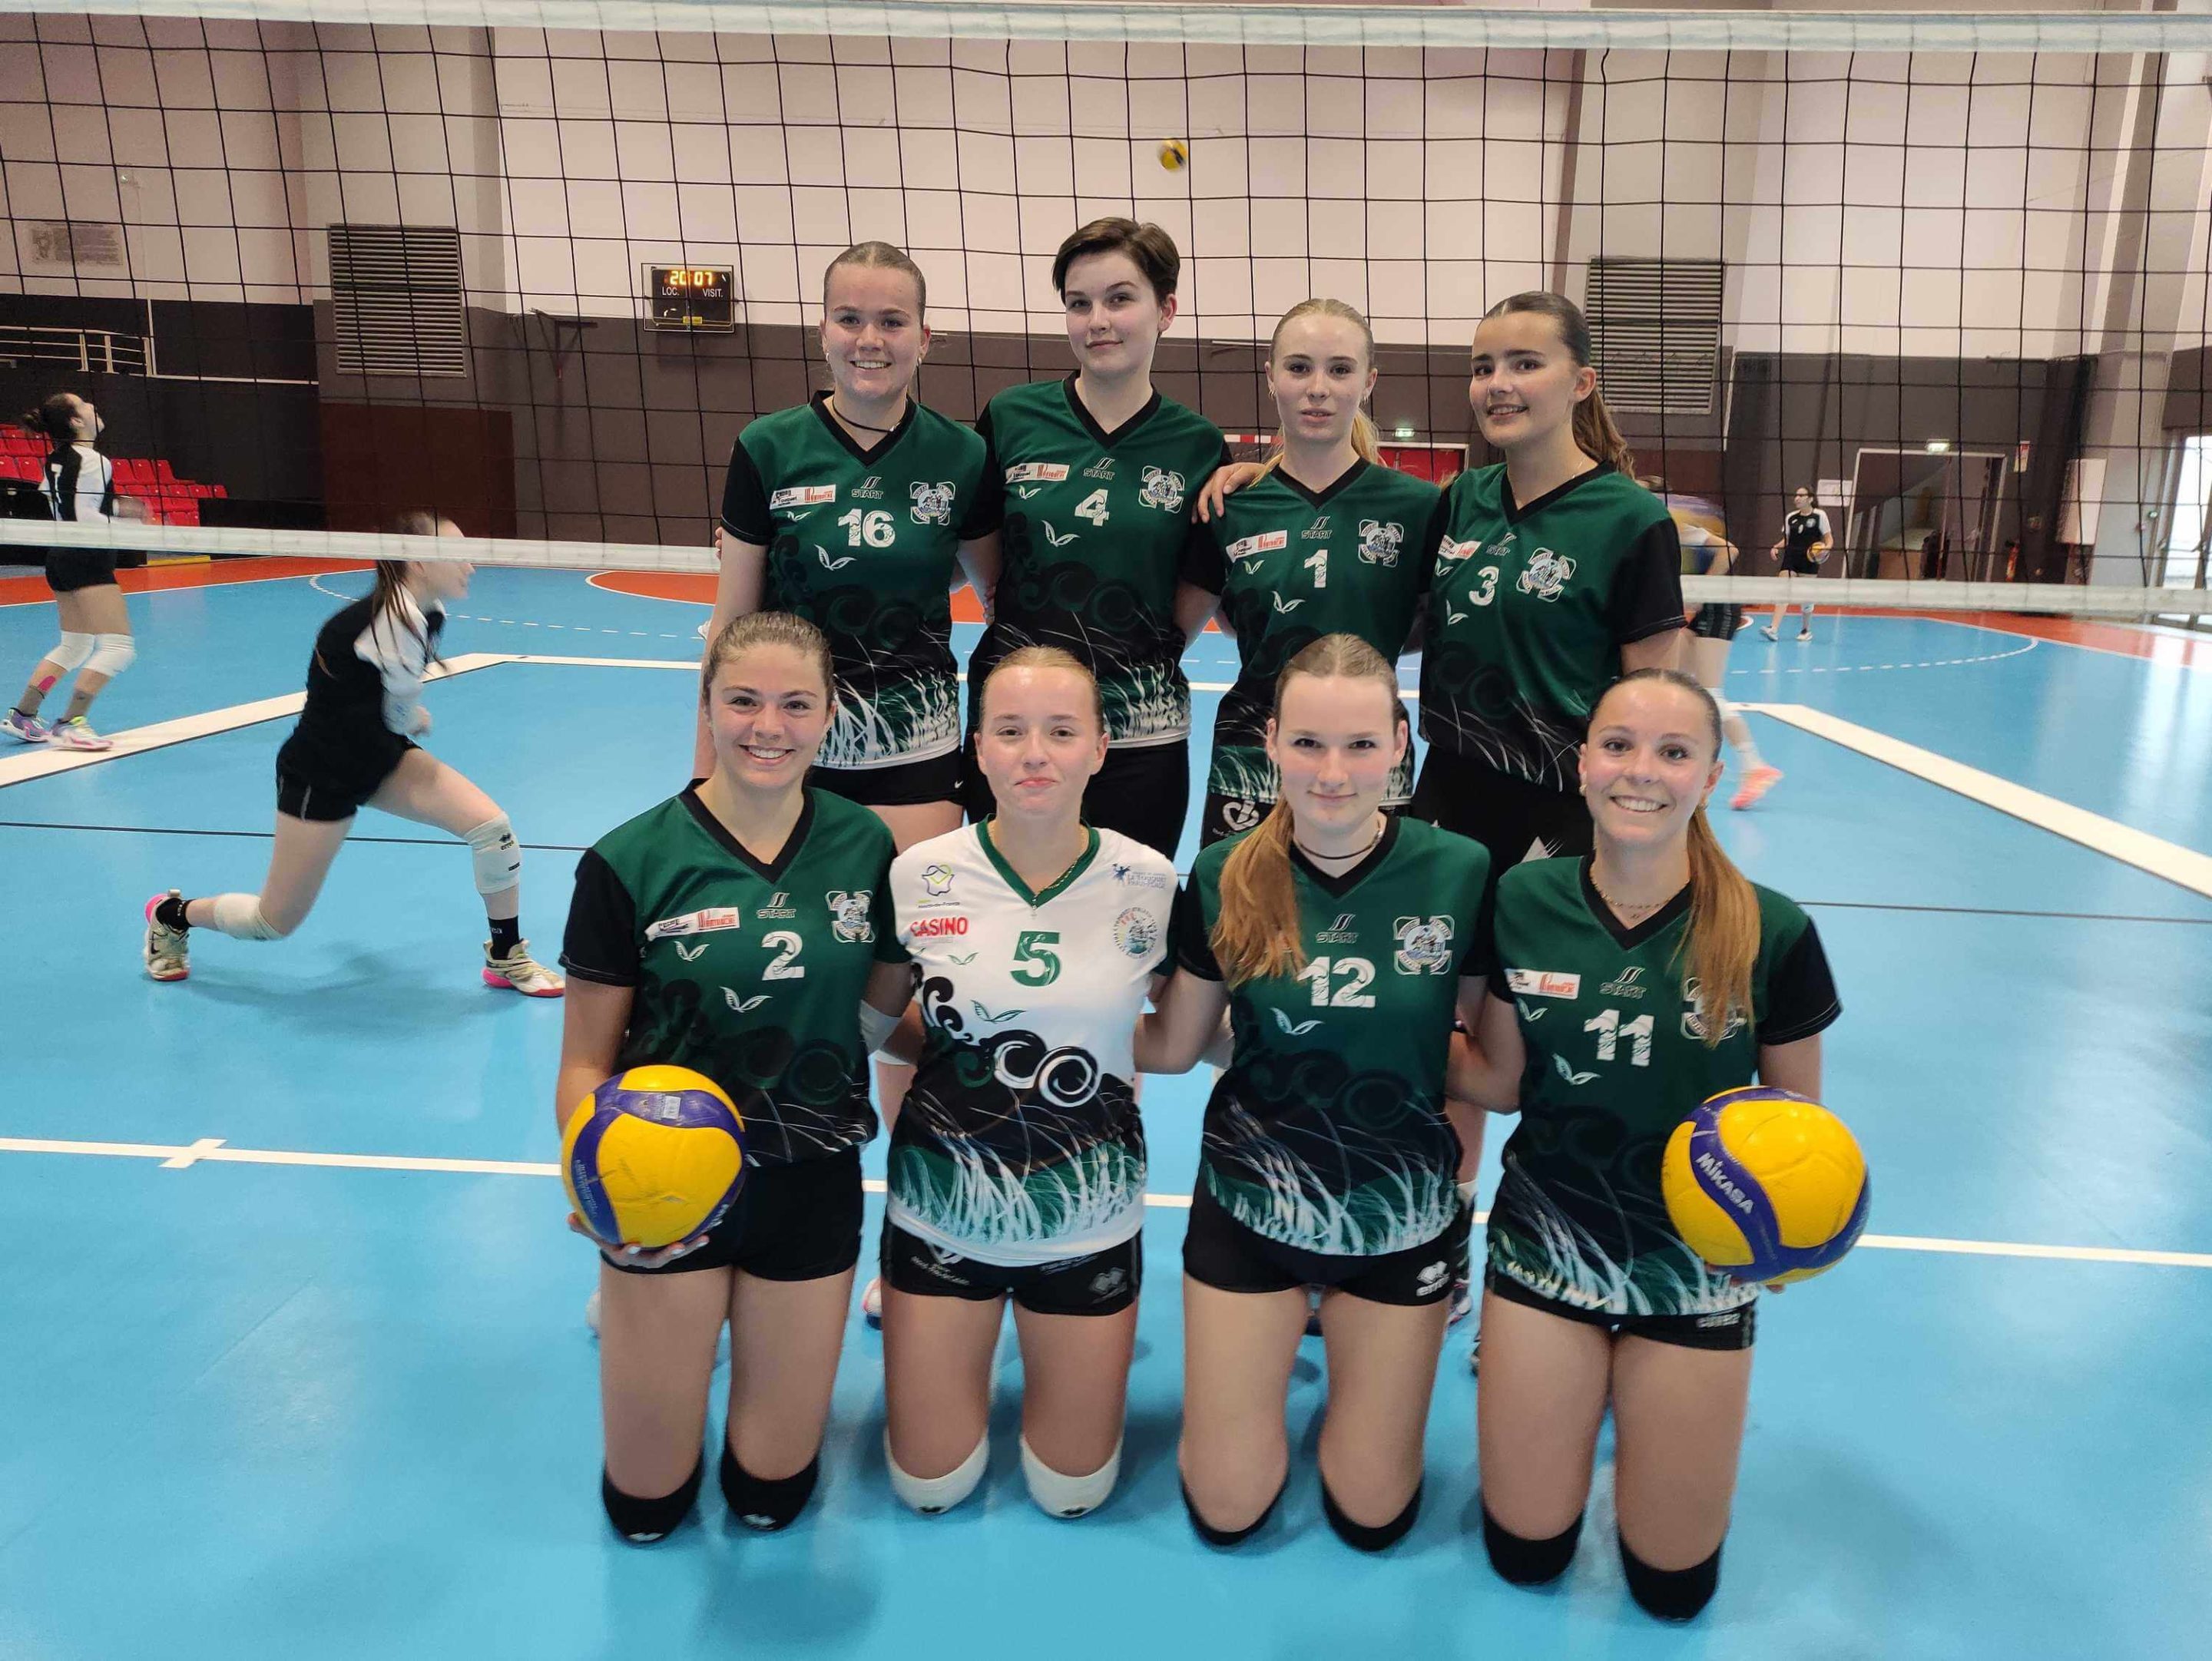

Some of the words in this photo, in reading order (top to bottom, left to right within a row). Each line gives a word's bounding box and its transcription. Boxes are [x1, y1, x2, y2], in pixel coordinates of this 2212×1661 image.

[662, 286, 680, 296] LOC.
[703, 288, 724, 298] VISIT.
[852, 488, 884, 499] START
[1083, 468, 1115, 480] START
[1075, 488, 1110, 527] 4
[838, 508, 896, 548] 16
[1304, 549, 1328, 588] 1
[1469, 566, 1499, 606] 3
[910, 917, 968, 937] CASINO
[761, 931, 805, 981] 2
[1011, 931, 1061, 987] 5
[1297, 956, 1376, 1008] 12
[1584, 1009, 1654, 1067] 11
